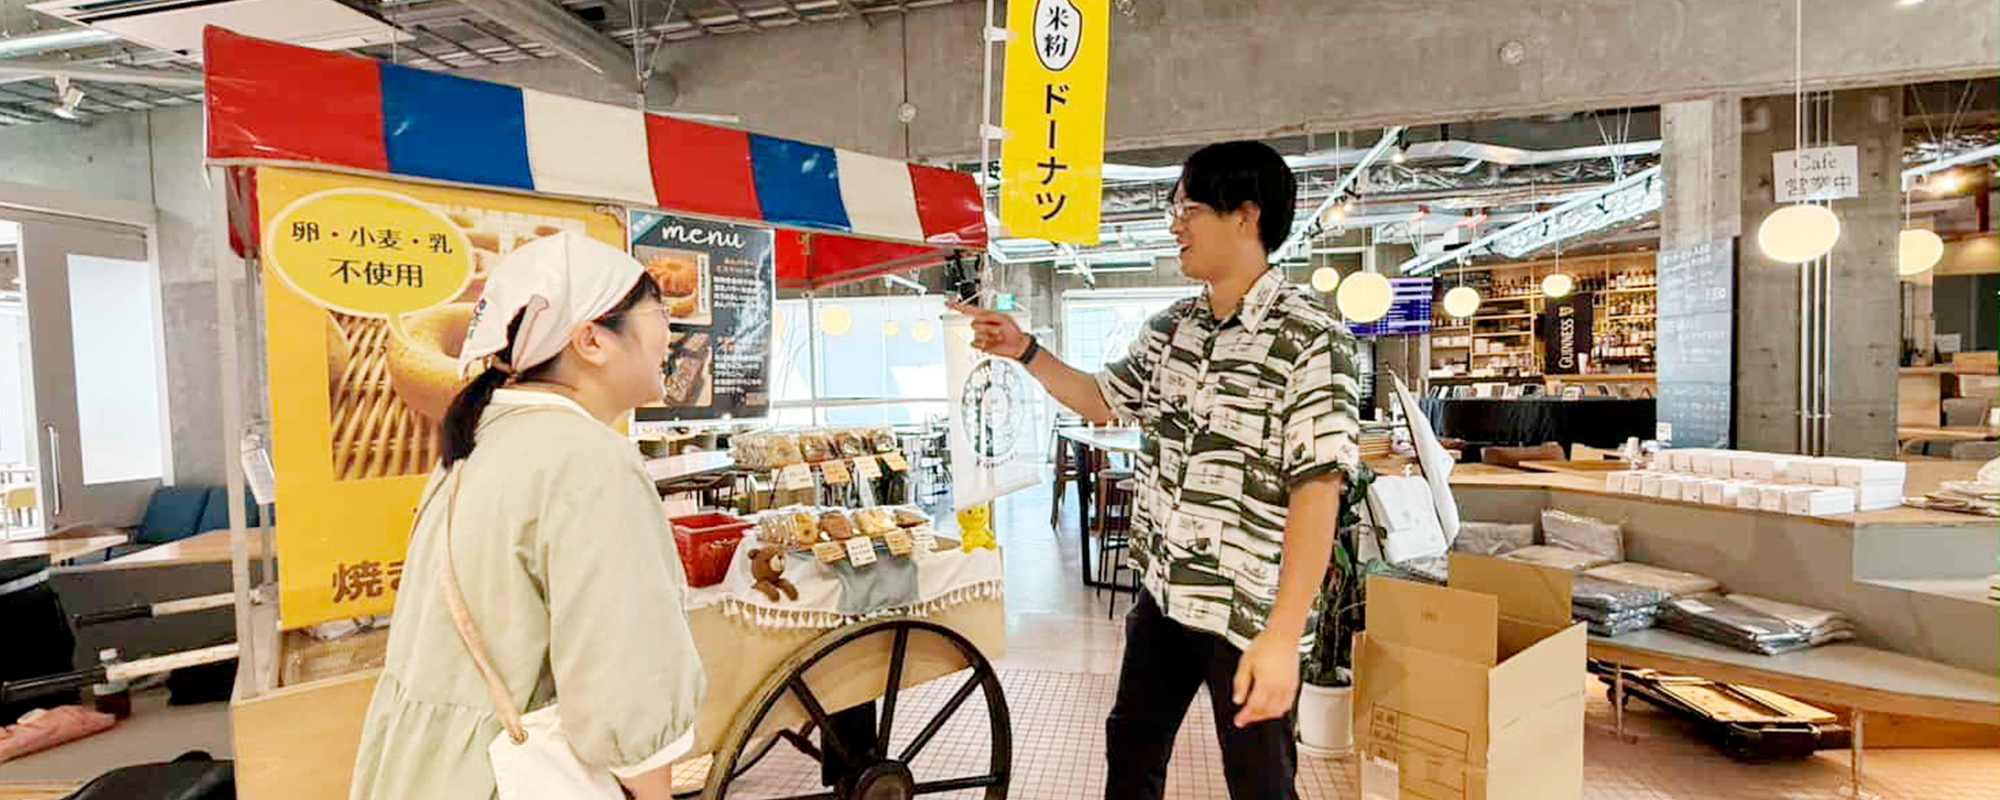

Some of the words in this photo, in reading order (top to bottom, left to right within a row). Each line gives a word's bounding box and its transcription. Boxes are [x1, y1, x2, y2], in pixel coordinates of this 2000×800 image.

[1045, 5, 1069, 58] 米粉
[1036, 84, 1068, 221] ドーナツ
[291, 221, 453, 254] 卵・小麦・乳
[661, 225, 746, 249] menu
[328, 257, 424, 289] 不使用
[1558, 318, 1575, 369] GUINNESS
